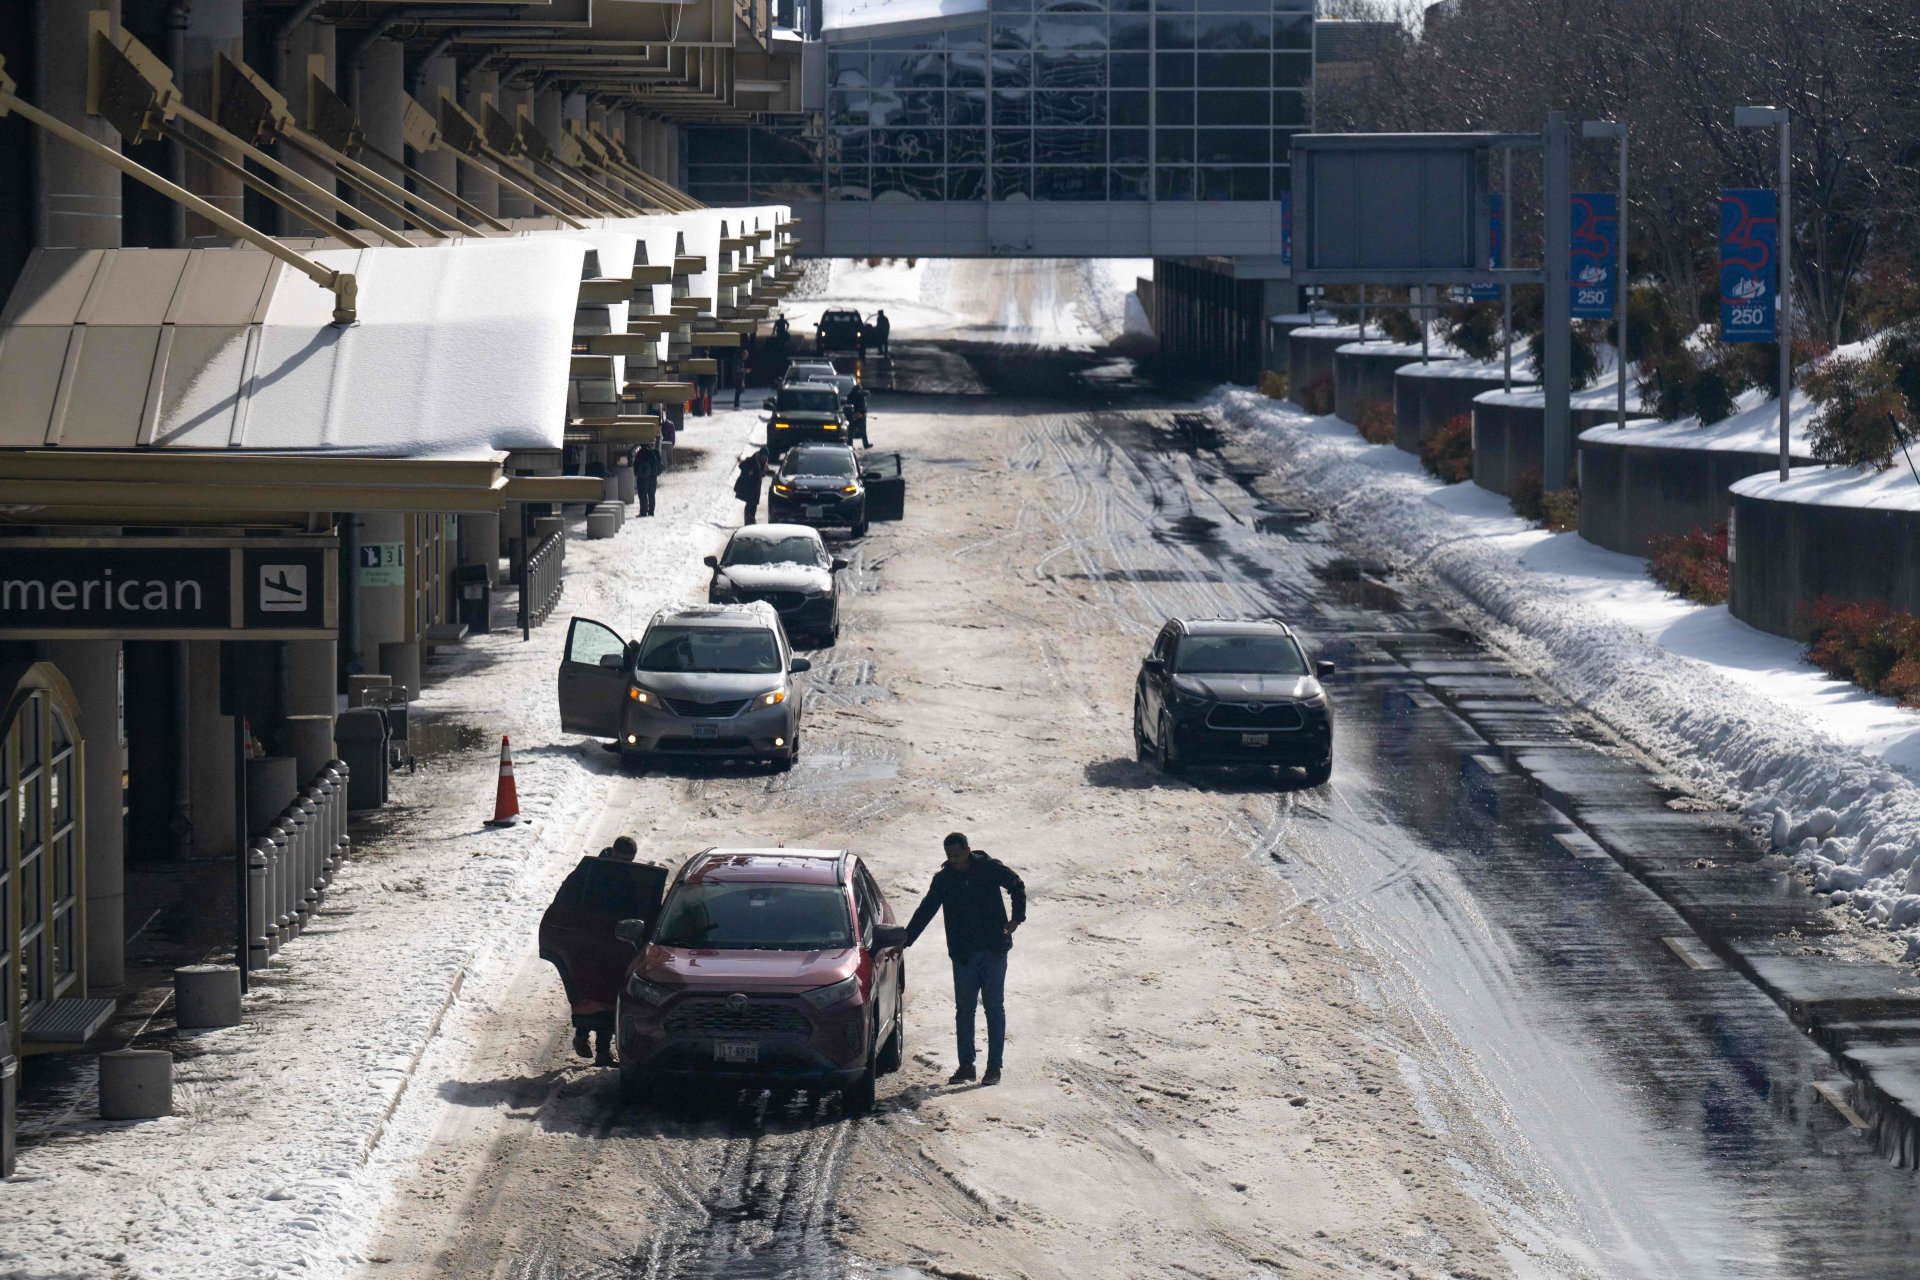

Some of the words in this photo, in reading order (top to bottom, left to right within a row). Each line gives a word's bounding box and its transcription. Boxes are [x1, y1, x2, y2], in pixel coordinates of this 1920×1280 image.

[1577, 290, 1605, 304] 250
[1731, 308, 1764, 325] 250
[387, 550, 393, 563] 3
[2, 568, 202, 610] merican
